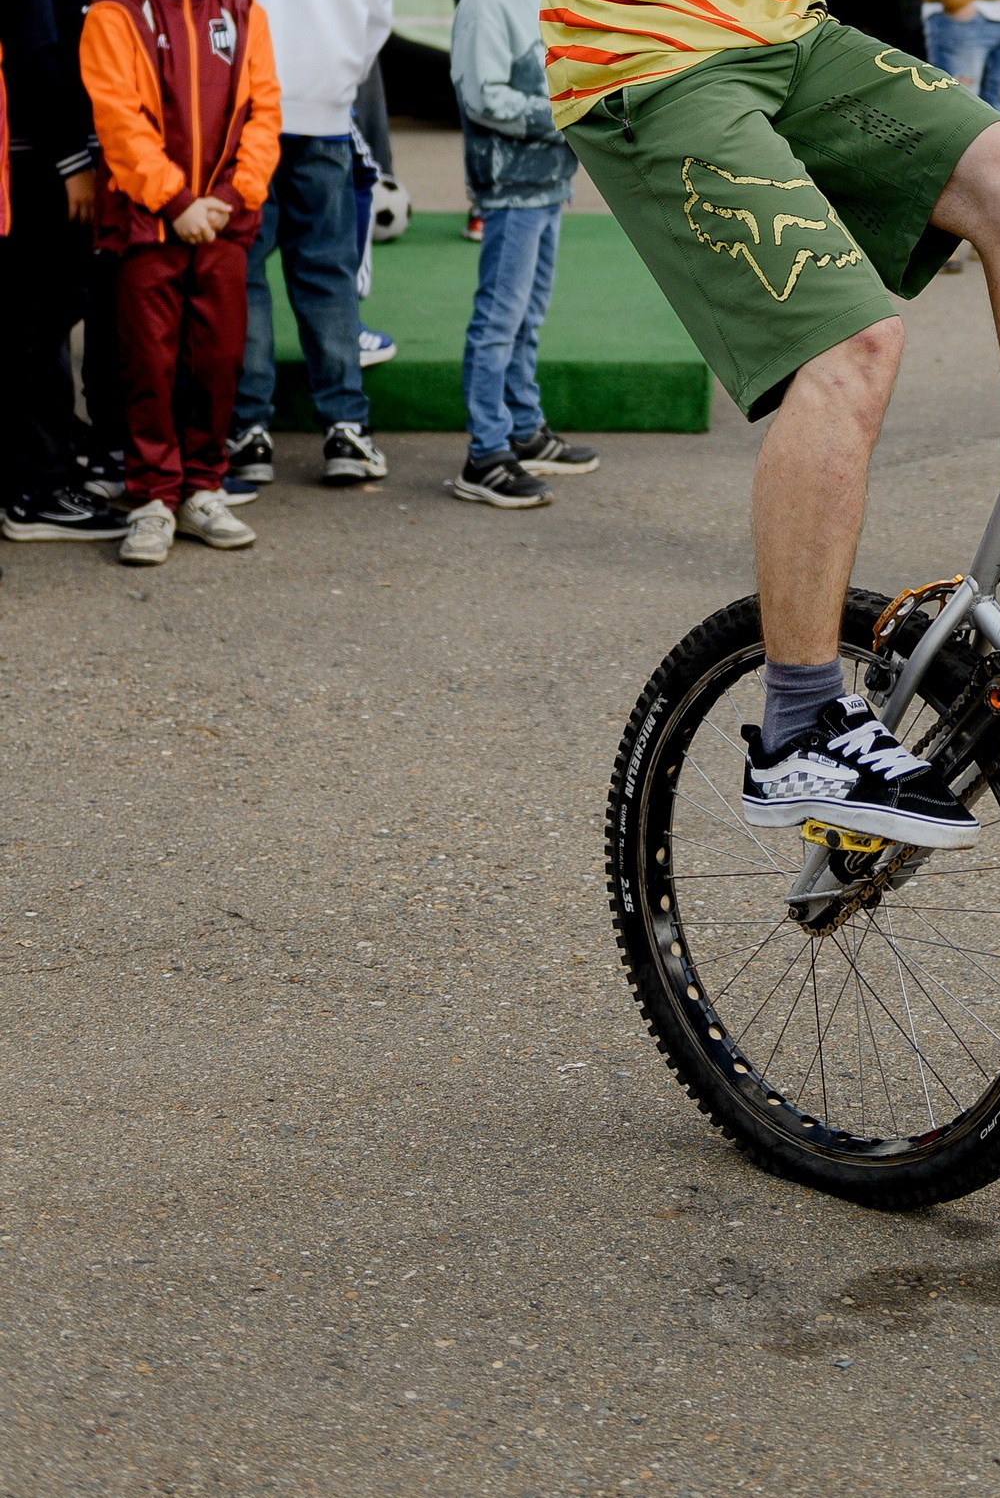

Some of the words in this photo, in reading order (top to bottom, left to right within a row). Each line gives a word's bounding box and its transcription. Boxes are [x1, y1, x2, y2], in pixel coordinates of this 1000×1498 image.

[847, 699, 866, 710] VANS
[623, 715, 658, 799] MICHELIN
[620, 876, 634, 914] 2.35
